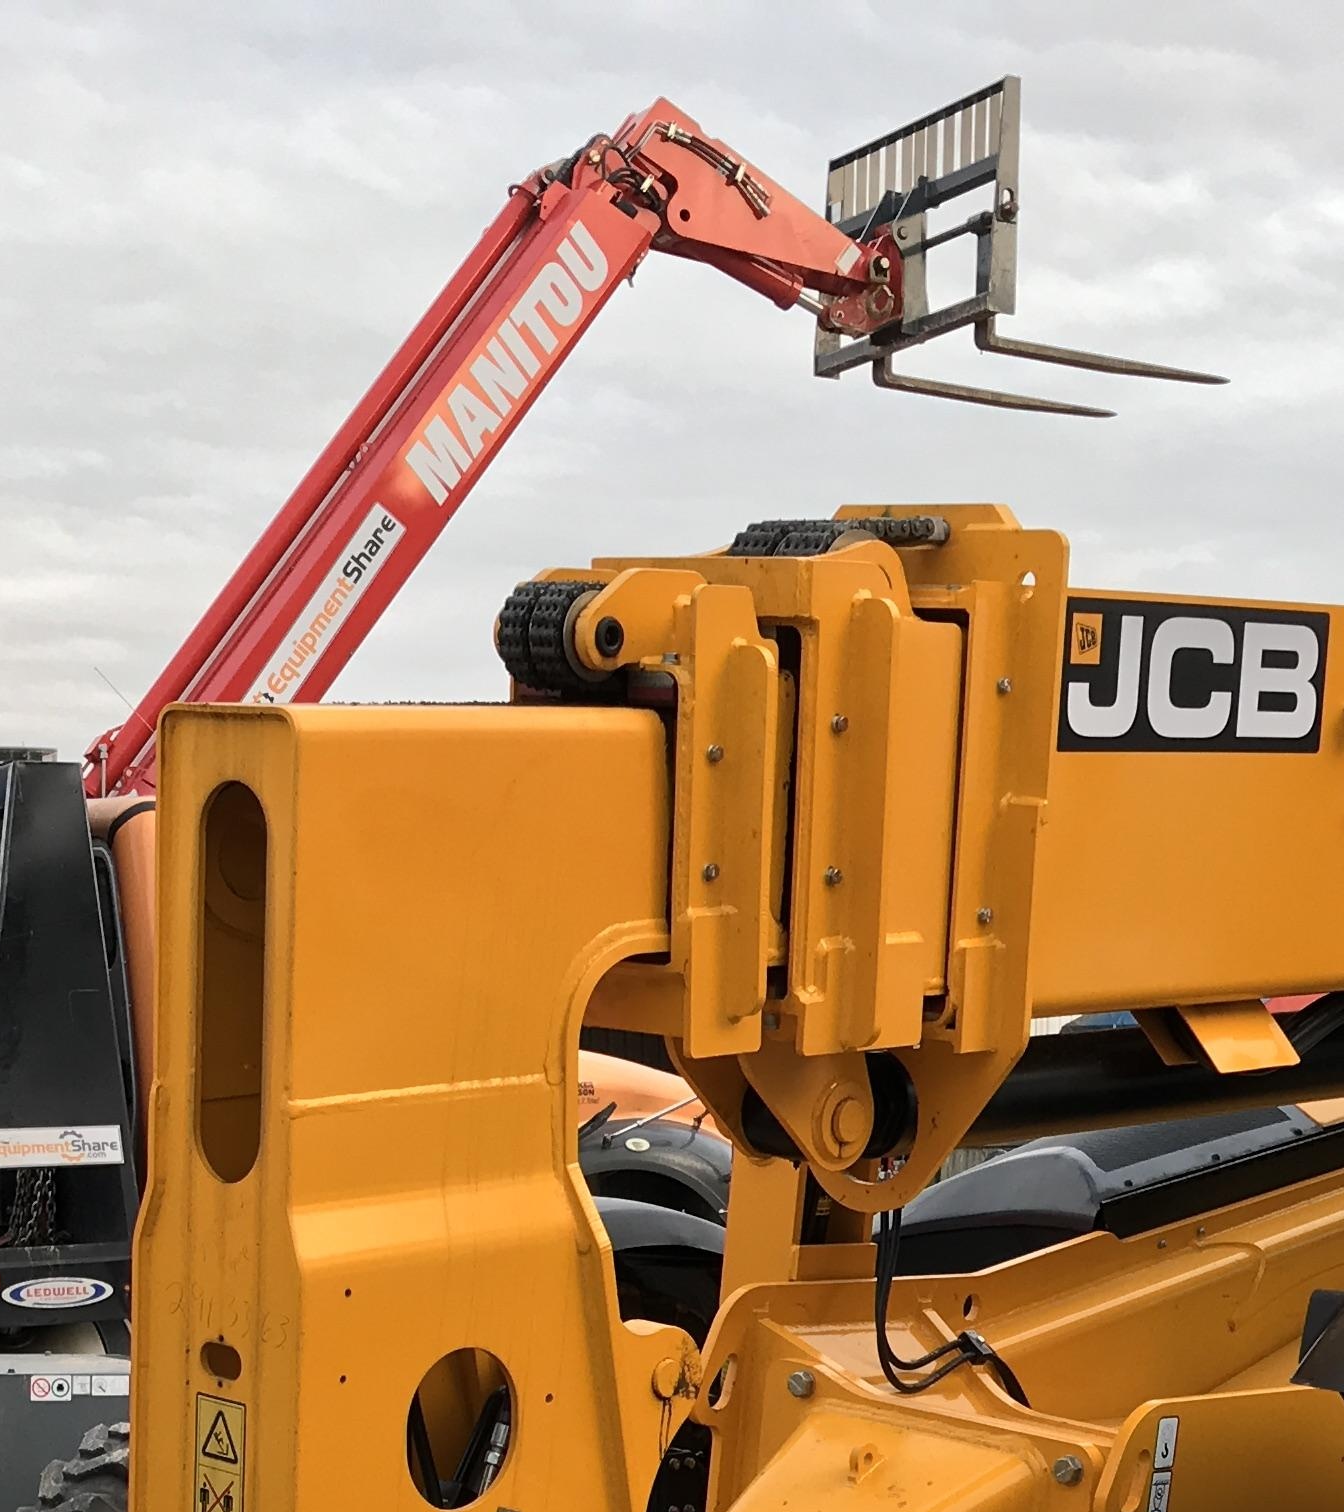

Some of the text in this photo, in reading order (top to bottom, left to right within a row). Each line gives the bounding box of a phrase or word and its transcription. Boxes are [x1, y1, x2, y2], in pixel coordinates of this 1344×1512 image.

[405, 219, 609, 507] MANITOU
[267, 514, 397, 695] EquipmentShare
[1078, 626, 1098, 651] JCB
[1067, 614, 1320, 739] JCB
[26, 1286, 90, 1298] LEDWELL
